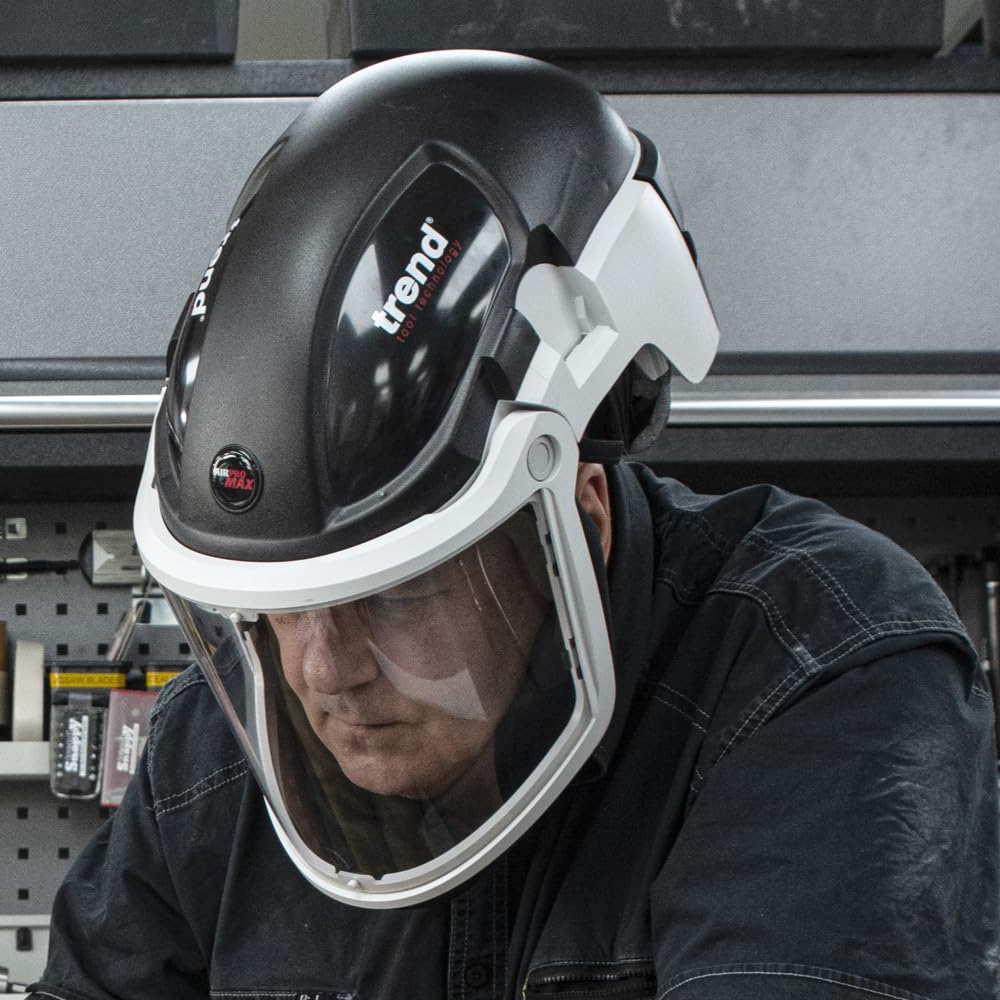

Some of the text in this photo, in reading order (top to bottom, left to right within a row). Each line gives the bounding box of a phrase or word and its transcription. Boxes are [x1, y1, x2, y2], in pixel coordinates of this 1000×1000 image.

[371, 223, 449, 335] trend
[396, 240, 463, 343] tool technology
[225, 477, 254, 490] MAX
[64, 717, 82, 773] Snappy
[116, 724, 135, 772] Snappy
